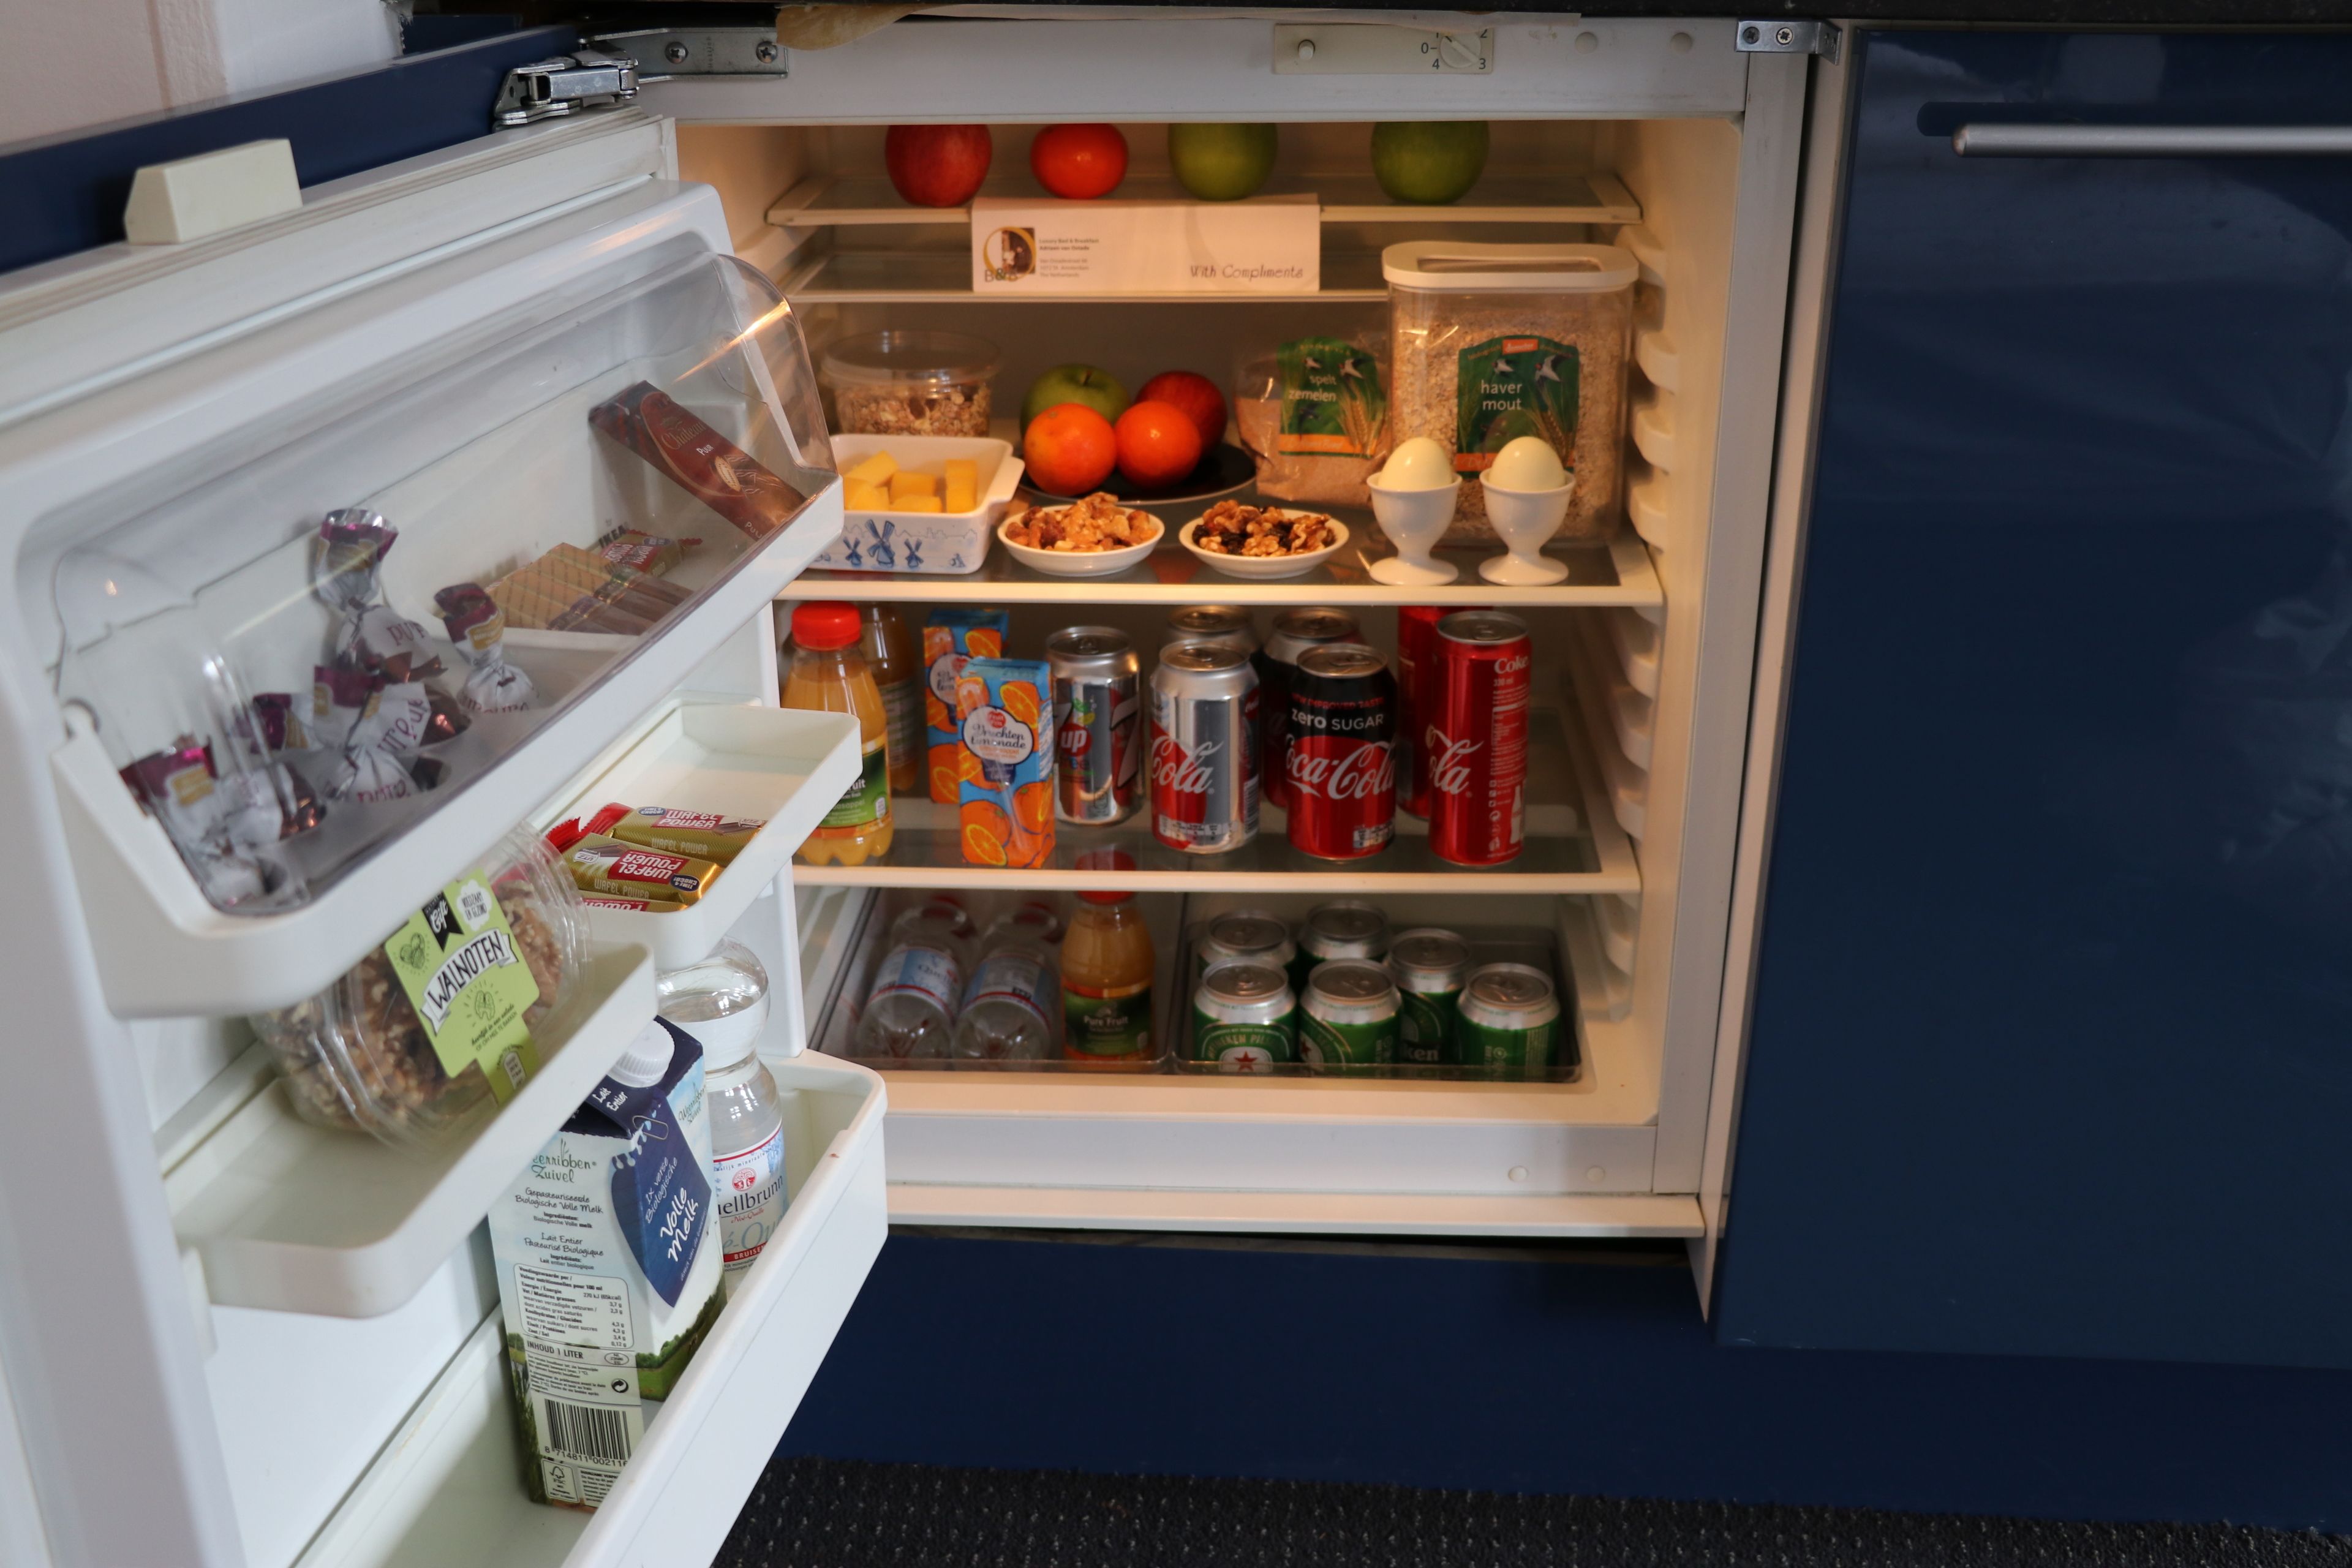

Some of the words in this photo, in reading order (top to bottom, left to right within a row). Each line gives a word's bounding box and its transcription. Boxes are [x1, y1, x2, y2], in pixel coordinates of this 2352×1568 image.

[1421, 43, 1429, 54] 0
[1432, 58, 1440, 70] 4
[1479, 58, 1486, 69] 3
[1190, 265, 1216, 279] With
[1221, 264, 1304, 282] Compliments
[1289, 389, 1336, 402] zemelen
[1481, 380, 1522, 394] haver
[1483, 399, 1521, 410] mout
[598, 524, 627, 549] IKEA
[1494, 656, 1528, 674] Coke
[1291, 708, 1327, 729] zero
[1331, 714, 1384, 730] SUGAR
[1060, 729, 1087, 753] up
[659, 818, 716, 827] POWER
[666, 810, 718, 821] WAFEL
[651, 837, 678, 851] WAFEL
[680, 842, 708, 855] POWER
[622, 853, 682, 870] POWER
[618, 862, 673, 880] WAFEL
[594, 878, 620, 893] WAFEL
[622, 888, 649, 900] POWER
[428, 930, 505, 1010] WALNOTEN
[592, 1087, 611, 1103] Lait
[606, 1091, 629, 1112] Entier
[531, 1165, 575, 1183] Zuivel
[654, 1156, 669, 1186] verse
[526, 1187, 590, 1204] Gepasteuriseerde
[645, 1156, 678, 1224] Biologische
[515, 1194, 557, 1208] Biologische
[560, 1202, 578, 1211] Volle
[581, 1204, 603, 1213] Melk
[660, 1187, 687, 1238] Volle
[541, 1232, 557, 1242] Lait
[560, 1235, 583, 1245] Entier
[668, 1198, 699, 1262] Melk
[524, 1237, 561, 1251] Pasteurisé
[563, 1245, 604, 1258] Biologique
[567, 1262, 594, 1270] biologique
[527, 1340, 554, 1354] INHOUD
[564, 1350, 584, 1359] LITER
[556, 1448, 589, 1463] 714811
